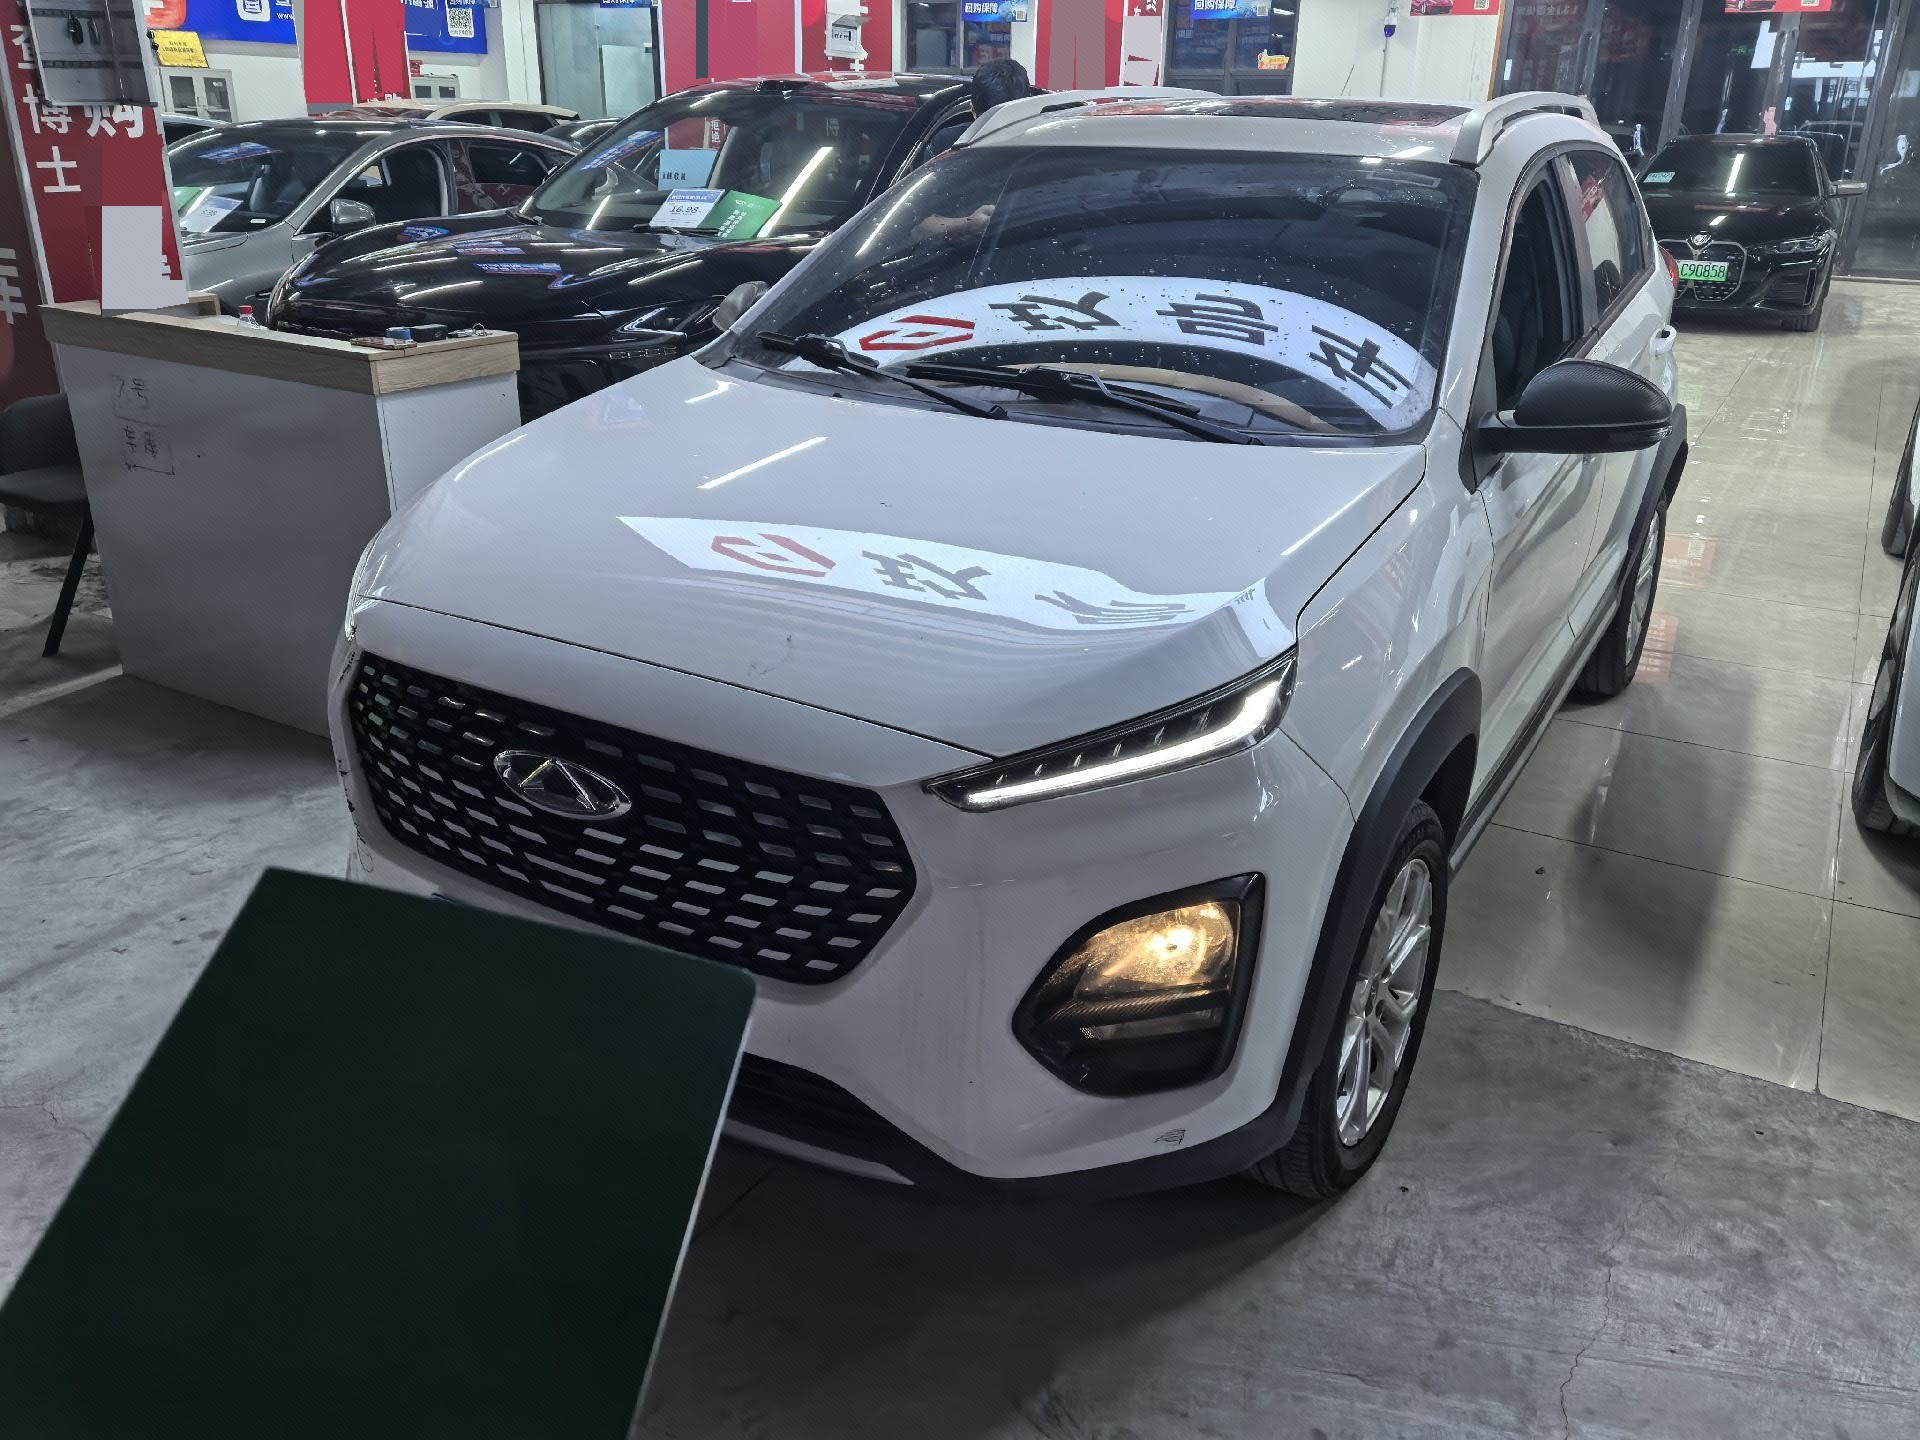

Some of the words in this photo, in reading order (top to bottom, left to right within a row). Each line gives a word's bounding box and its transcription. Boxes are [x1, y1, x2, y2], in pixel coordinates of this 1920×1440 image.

[965, 2, 998, 14] 回购保障
[1681, 263, 1726, 278] C90858
